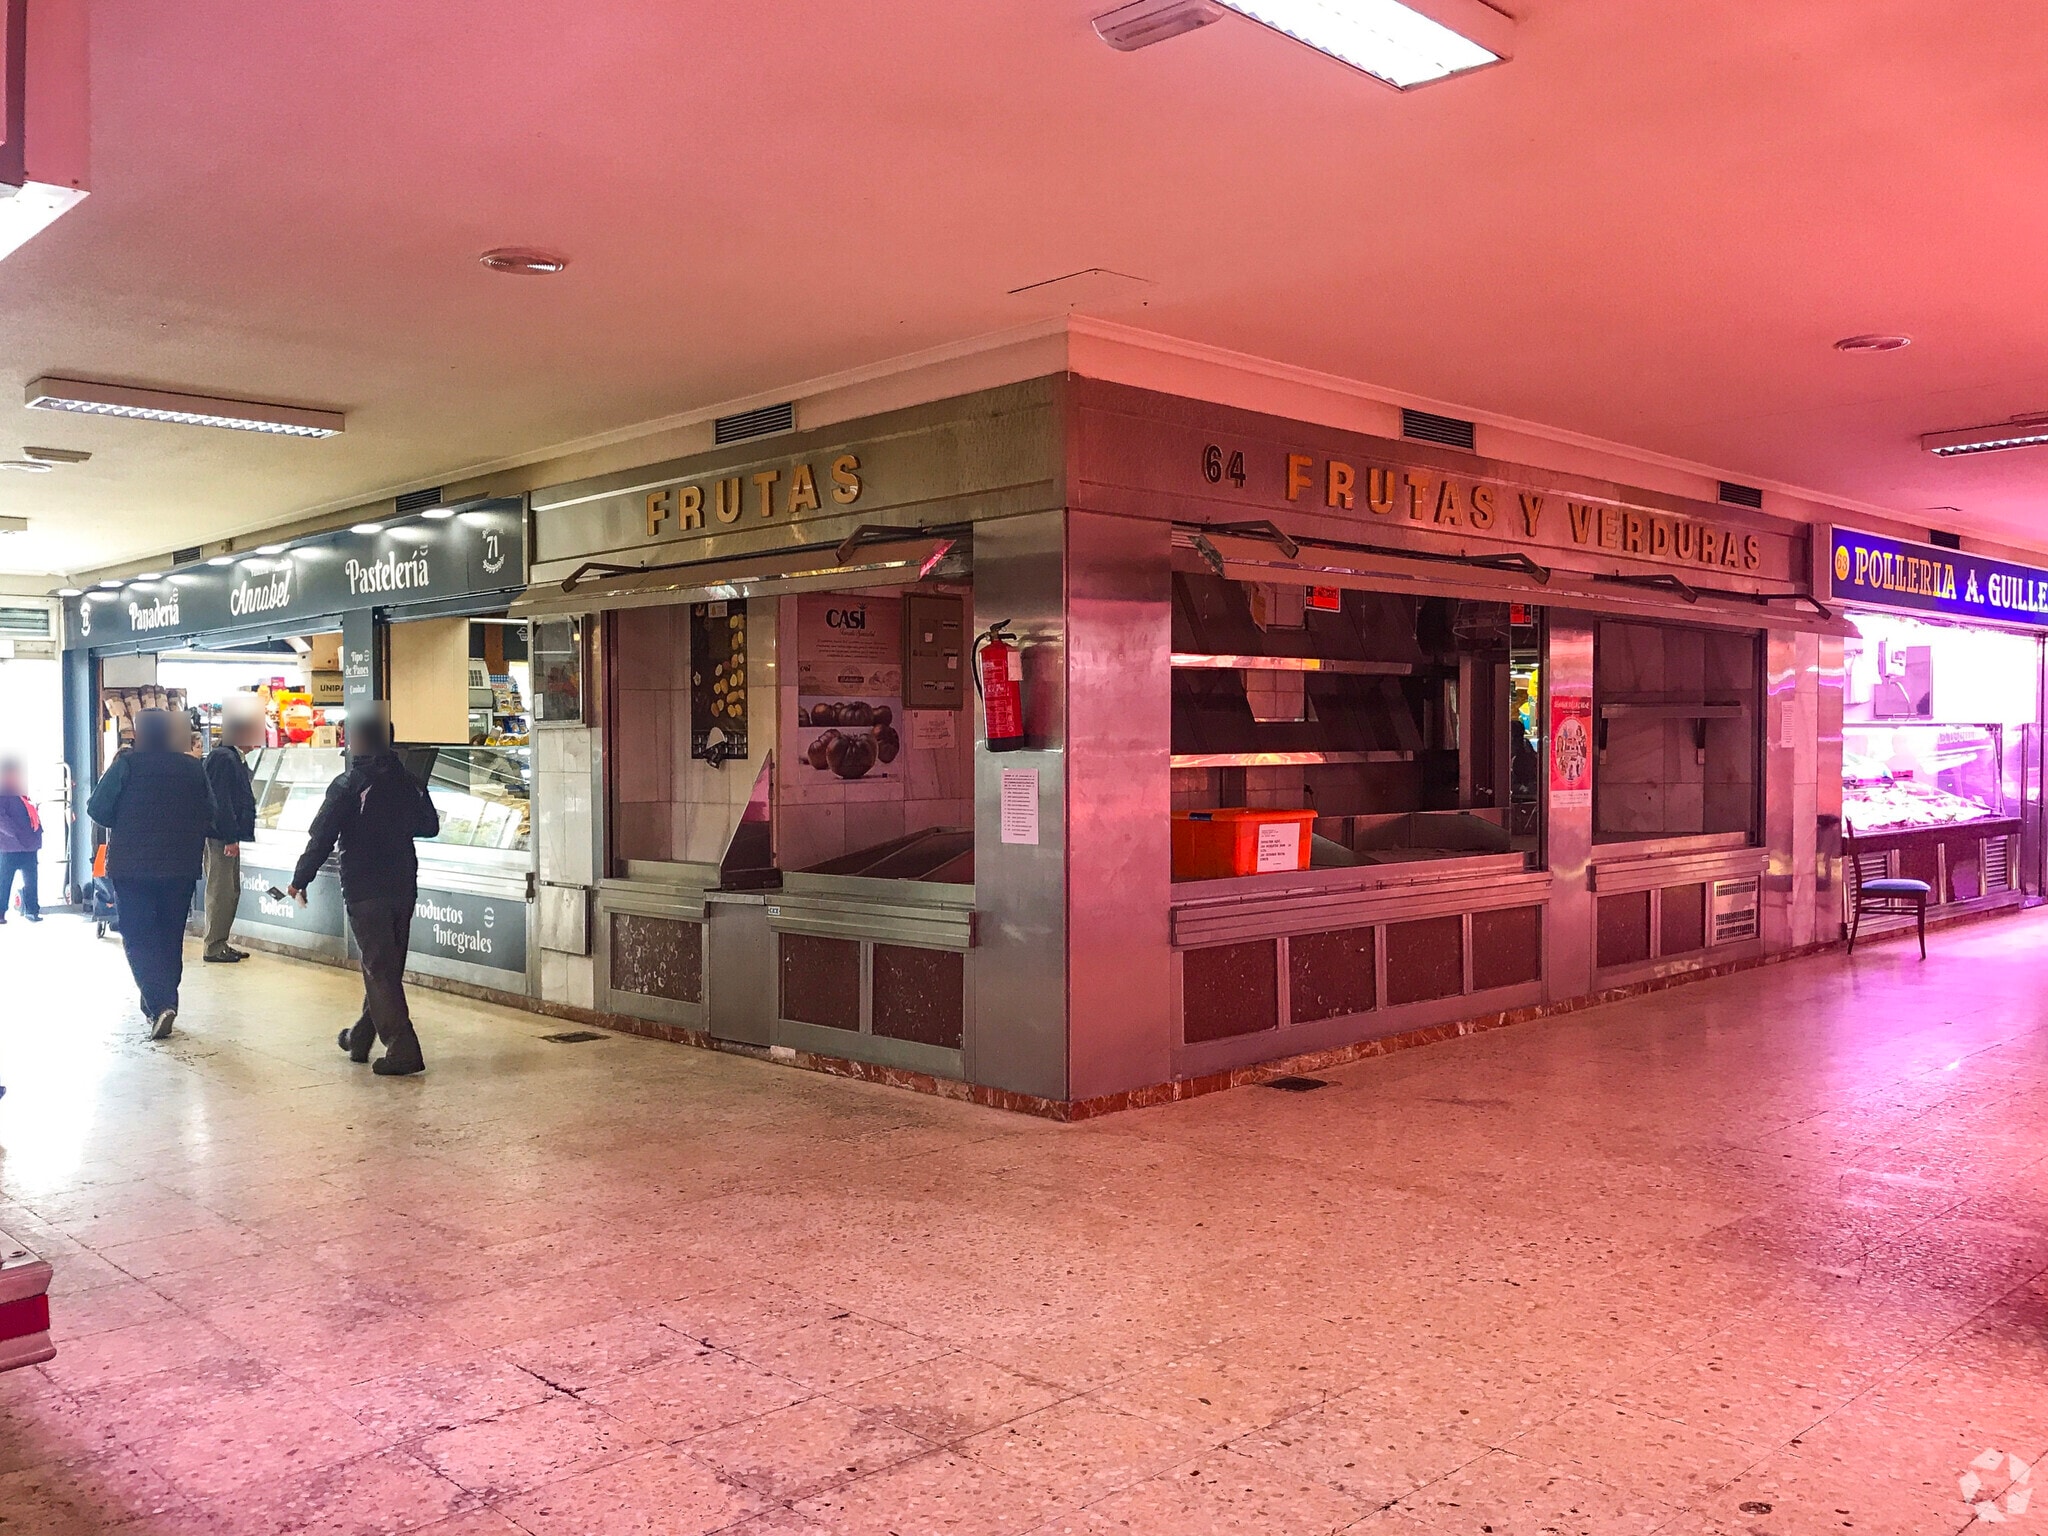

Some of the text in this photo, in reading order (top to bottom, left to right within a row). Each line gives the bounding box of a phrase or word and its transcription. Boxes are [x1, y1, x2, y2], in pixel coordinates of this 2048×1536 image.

[646, 454, 863, 536] FRUTAS
[1203, 444, 1762, 570] 64 FRUTAS Y VERDURAS
[486, 535, 499, 559] 71
[230, 570, 291, 616] Annabel
[345, 551, 430, 595] Pastelería
[1836, 553, 1848, 571] 63
[1854, 546, 1957, 600] POLLERIA
[1964, 569, 1985, 604] A.
[129, 597, 179, 632] Panadería
[413, 901, 463, 923] roductos
[433, 924, 492, 954] Integrales
